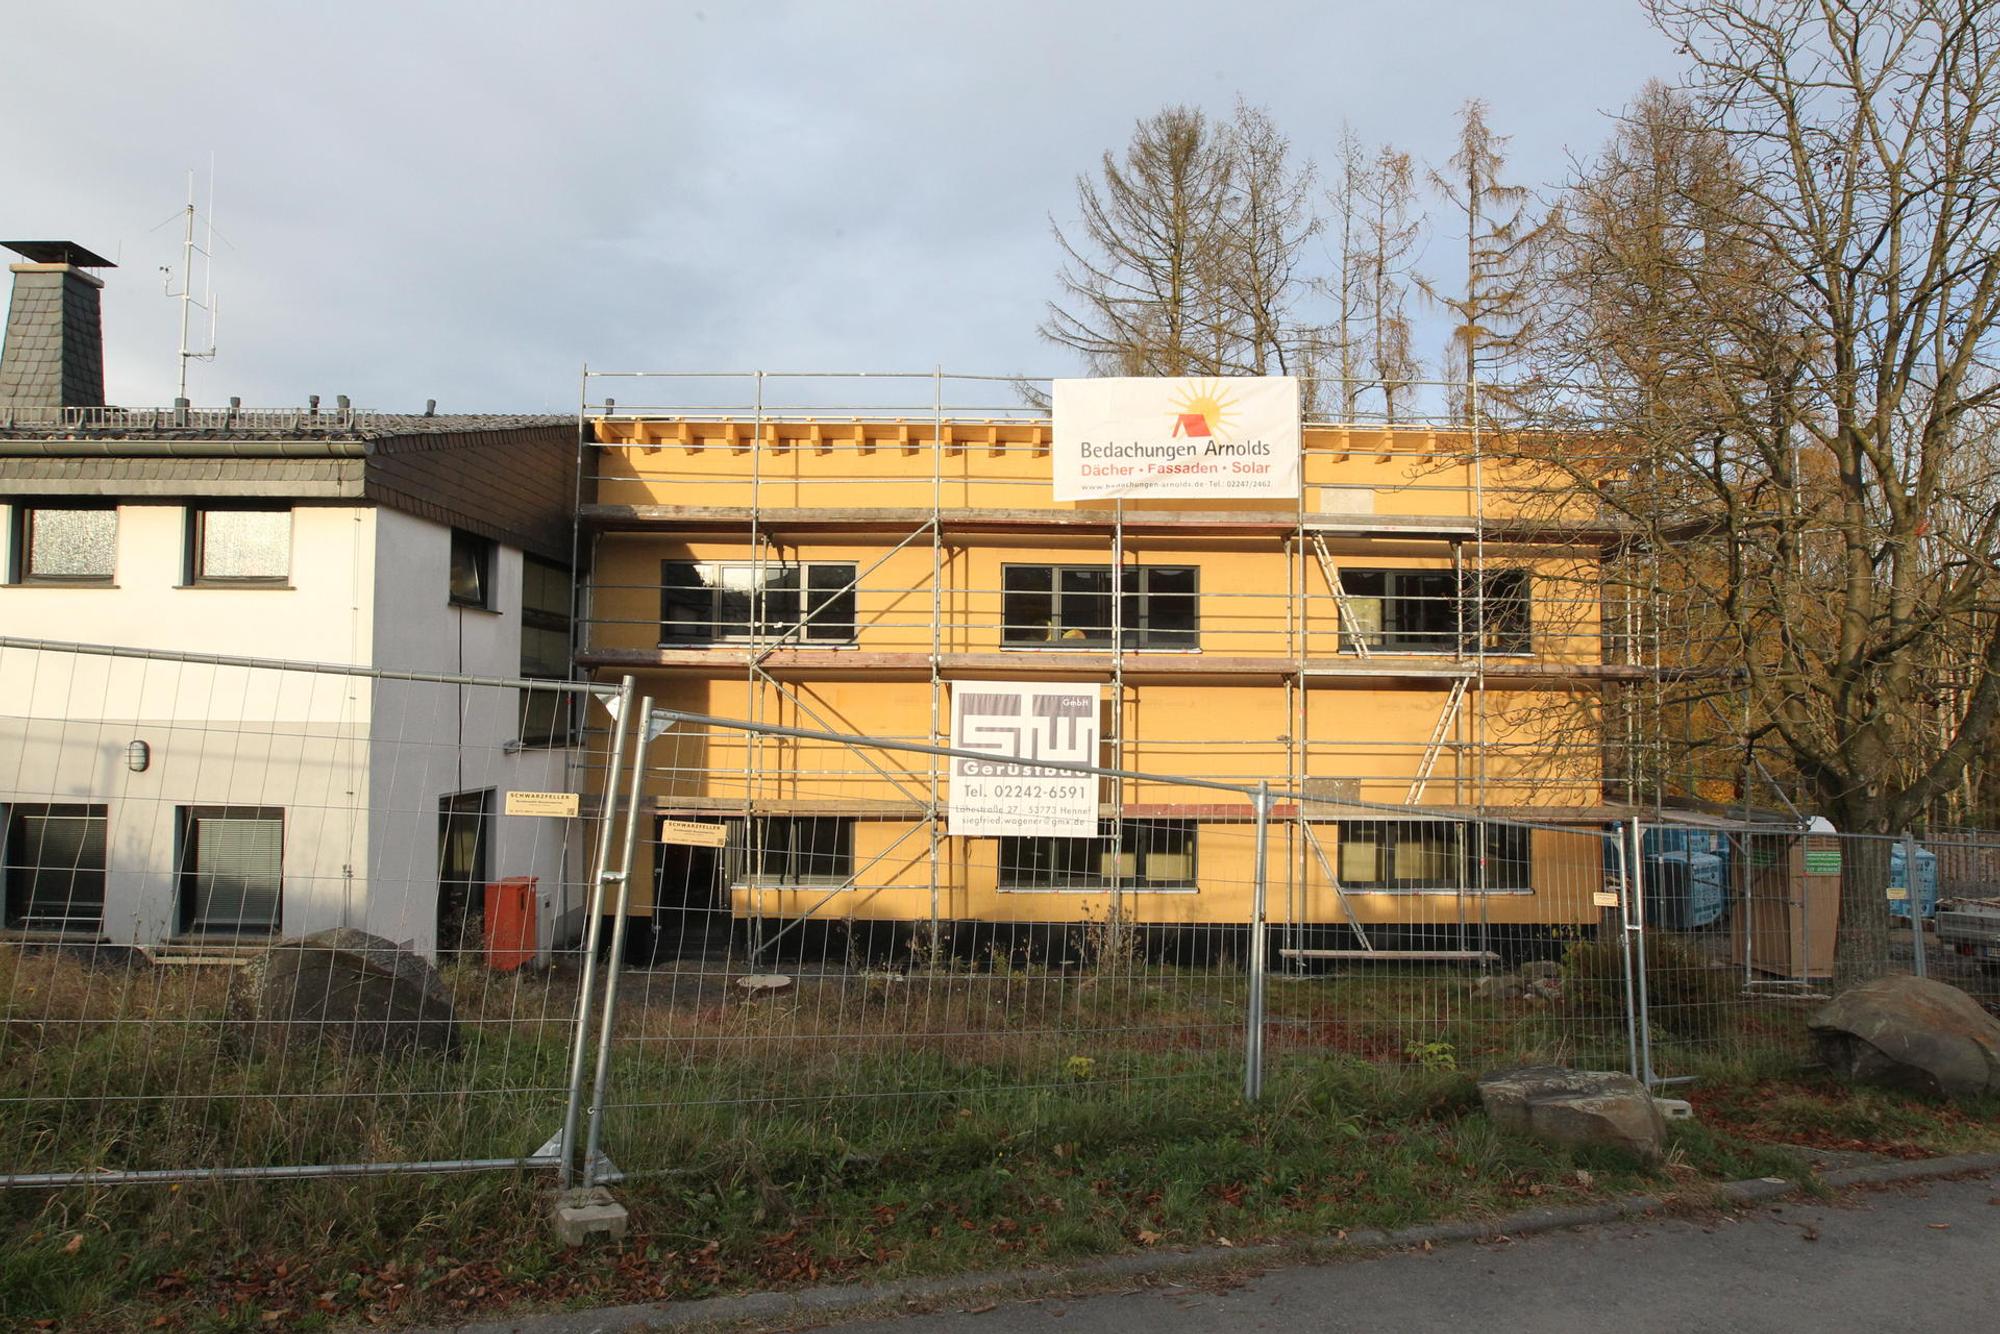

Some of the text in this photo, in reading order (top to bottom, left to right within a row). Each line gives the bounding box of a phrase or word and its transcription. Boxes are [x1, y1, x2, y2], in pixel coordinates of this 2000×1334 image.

[1081, 440, 1271, 461] Bedachungen Arnolds
[1081, 461, 1270, 477] Dächer Fassaden Solar
[1062, 698, 1089, 707] GmbH
[964, 784, 1085, 799] Tel. 02242-6591
[1028, 805, 1057, 814] 53773
